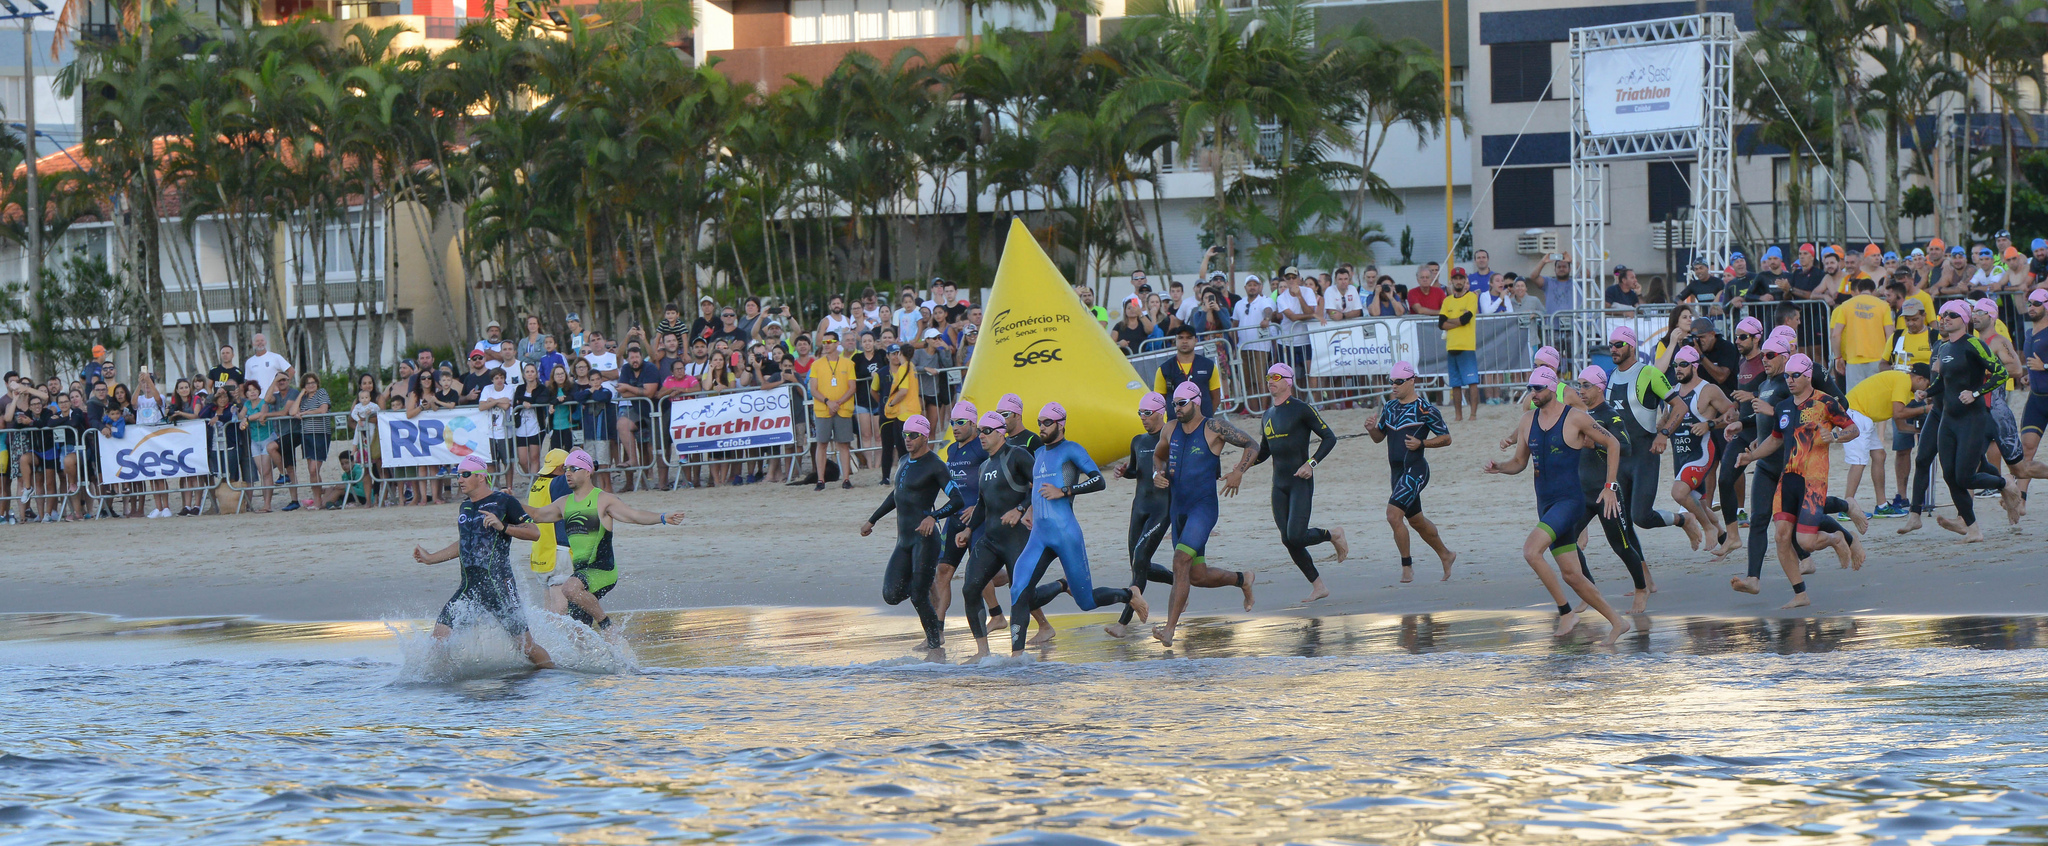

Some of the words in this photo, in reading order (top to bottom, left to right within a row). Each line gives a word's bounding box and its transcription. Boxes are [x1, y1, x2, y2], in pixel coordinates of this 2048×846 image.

[1648, 64, 1671, 83] Sesc
[1615, 86, 1671, 102] Triathlon
[995, 315, 1053, 336] Fecomércio
[1055, 314, 1071, 323] PR
[995, 336, 1010, 345] Sesc
[1015, 329, 1037, 337] Senac
[1357, 358, 1378, 366] Senac
[739, 393, 790, 413] Sesc
[671, 416, 791, 439] Triathlon
[389, 416, 479, 458] RPC
[716, 437, 752, 448] Caiobá
[1676, 445, 1692, 453] BRA
[116, 447, 196, 480] Sesc
[984, 469, 998, 481] TYR
[1072, 475, 1101, 489] PHANTO
